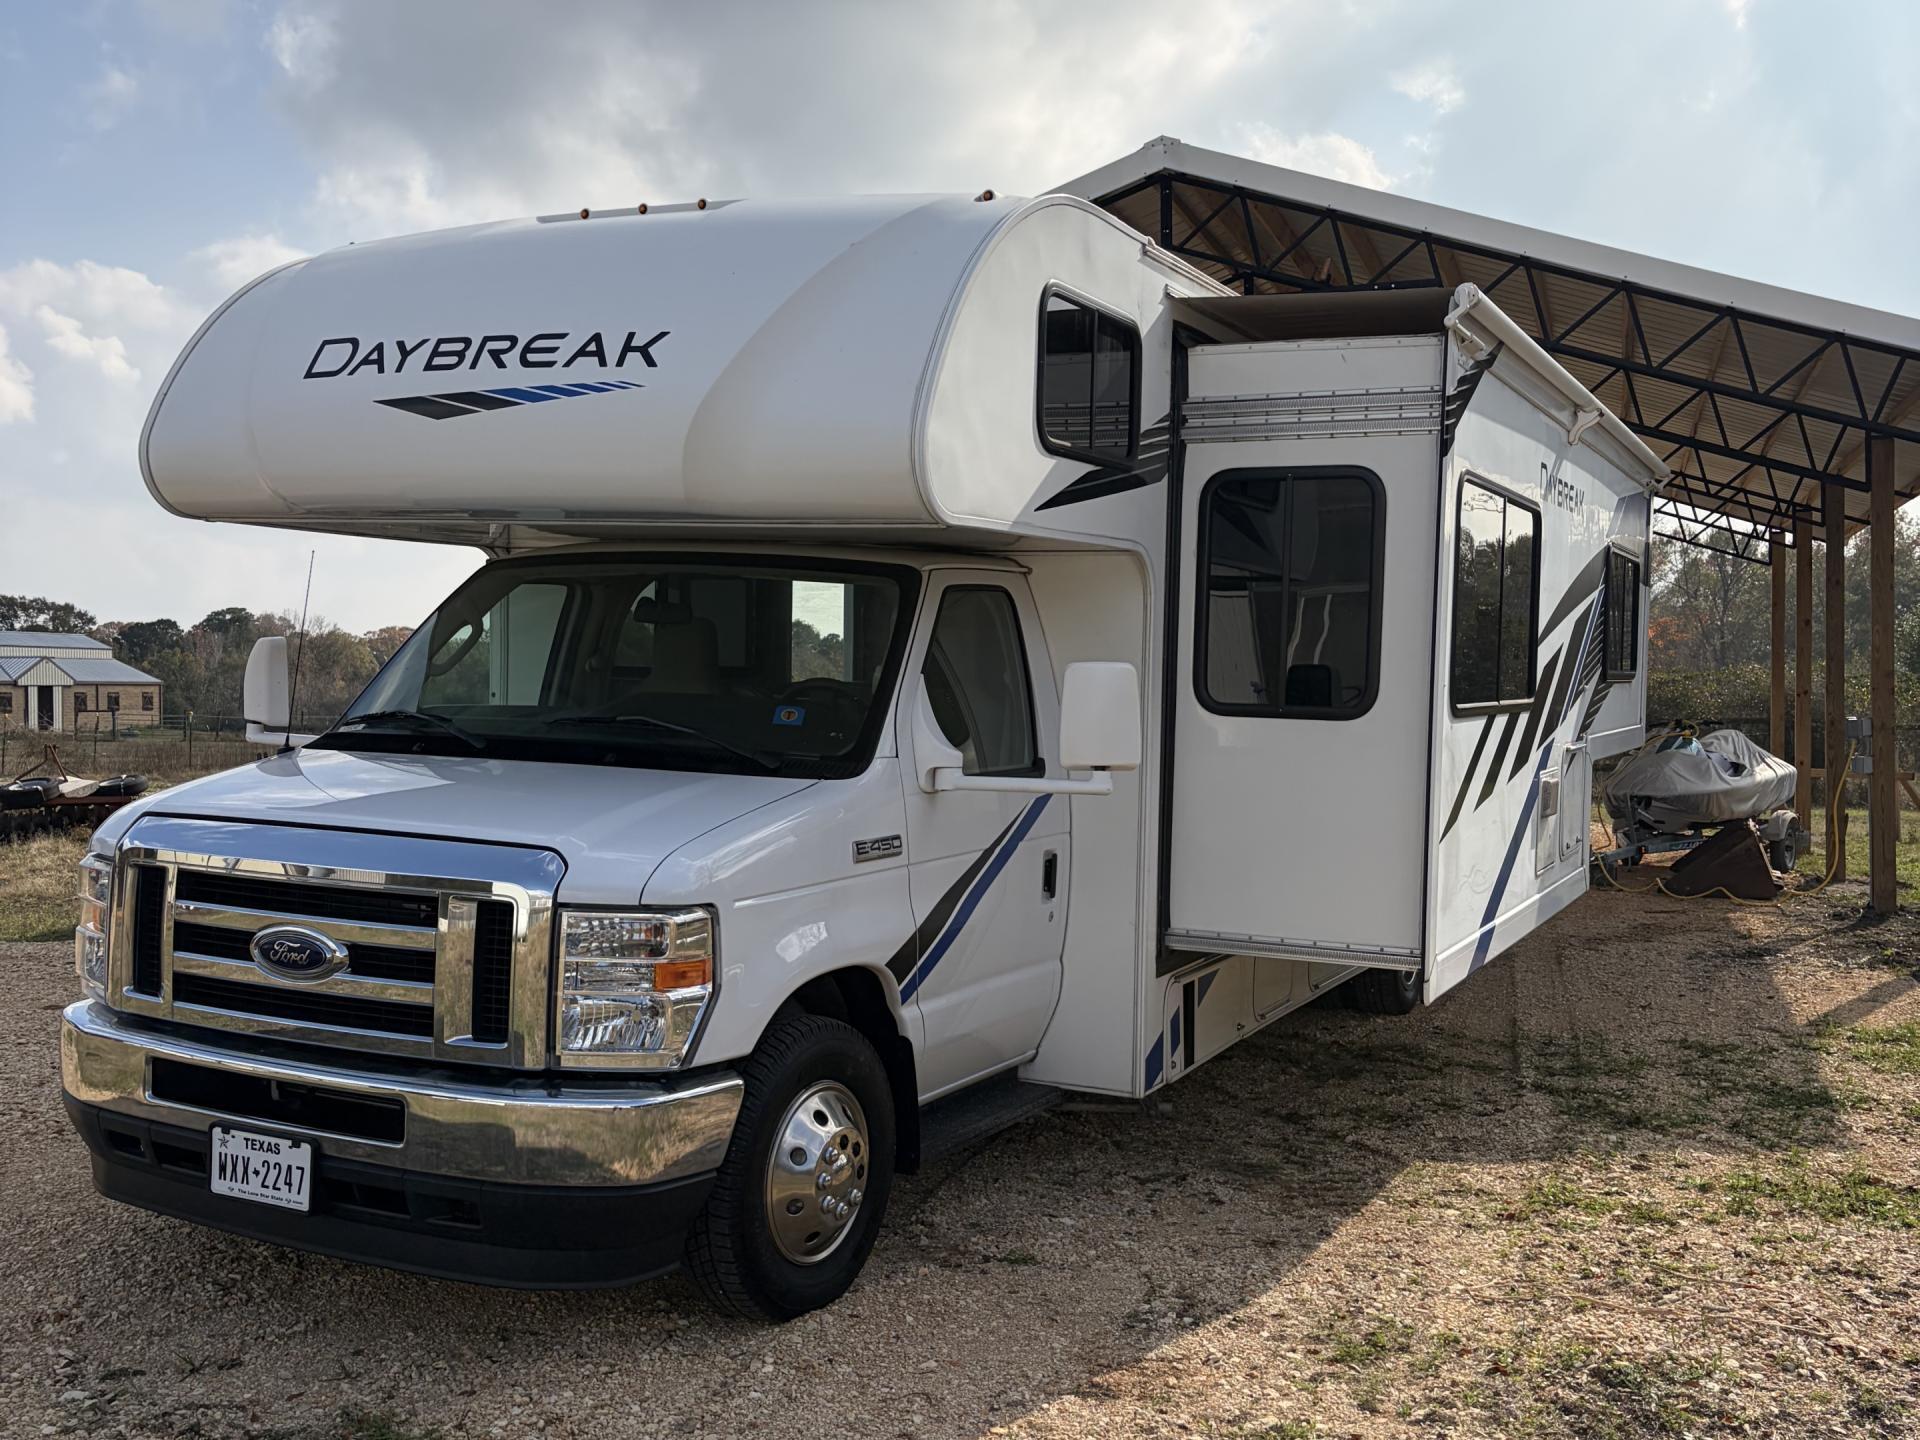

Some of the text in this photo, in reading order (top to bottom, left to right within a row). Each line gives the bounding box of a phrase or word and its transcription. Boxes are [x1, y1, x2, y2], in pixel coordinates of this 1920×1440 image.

[302, 331, 671, 380] DAYBREAK
[855, 836, 903, 856] E-450
[269, 940, 311, 965] Ford
[243, 1137, 281, 1155] TEXAS
